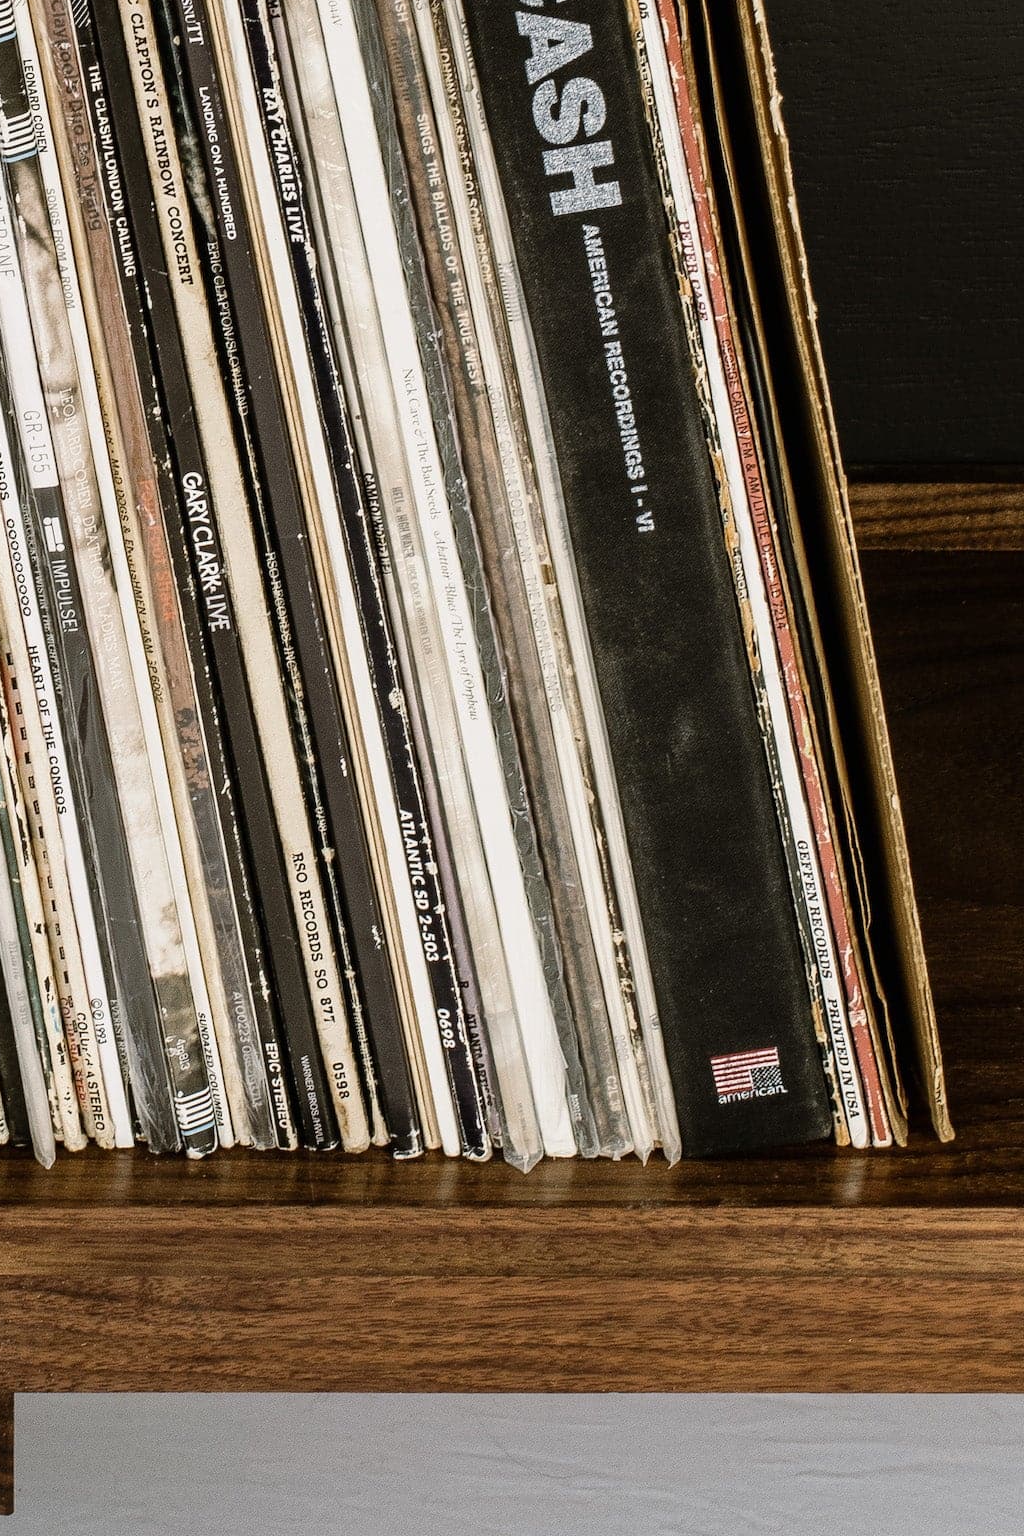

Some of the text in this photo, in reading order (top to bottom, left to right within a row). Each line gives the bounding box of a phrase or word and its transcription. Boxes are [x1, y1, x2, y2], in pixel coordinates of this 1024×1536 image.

[22, 59, 48, 152] LEONARD COHEN
[84, 62, 136, 277] THE CLASH/LONDON CALLING
[129, 13, 162, 109] CLAPTON'S
[149, 116, 177, 198] RAINBOW
[165, 206, 194, 286] CONCERT
[197, 86, 236, 240] LANDING ON HUNDRED
[262, 87, 305, 243] RAY CHARLES LIVE
[45, 188, 74, 308] SONGS FROM ROOM
[414, 113, 482, 386] SINGS THE BALLADS OF THE TRUE WEST
[676, 220, 699, 273] PETER
[22, 409, 50, 473] GR-155
[401, 368, 441, 521] Nick Bad Seeds
[581, 224, 654, 532] AMERICAN RECORDINGS VI
[58, 388, 105, 561] LEONARD COHEN DEATH
[729, 391, 769, 539] CARLIN/FM AM/LITTLE
[51, 559, 79, 633] IMPULSE!
[181, 471, 230, 632] GARY CLARK LIVE
[26, 645, 68, 815] HEART OF THE CONGOS
[291, 852, 329, 989] RSO RECORDS SO
[398, 808, 440, 962] ATLANTIC SD 2-503
[797, 839, 832, 979] GEFFEN RECORDS
[196, 1011, 225, 1127] SUNDAZED/COLUMBIA
[264, 1042, 290, 1128] EPIC STEREO
[300, 1055, 315, 1091] WARNER
[331, 1062, 351, 1099] 0598
[435, 1008, 455, 1048] 0698
[718, 1084, 785, 1104] american
[826, 998, 860, 1118] PRINTED IN USA
[87, 1080, 106, 1131] STEREO
